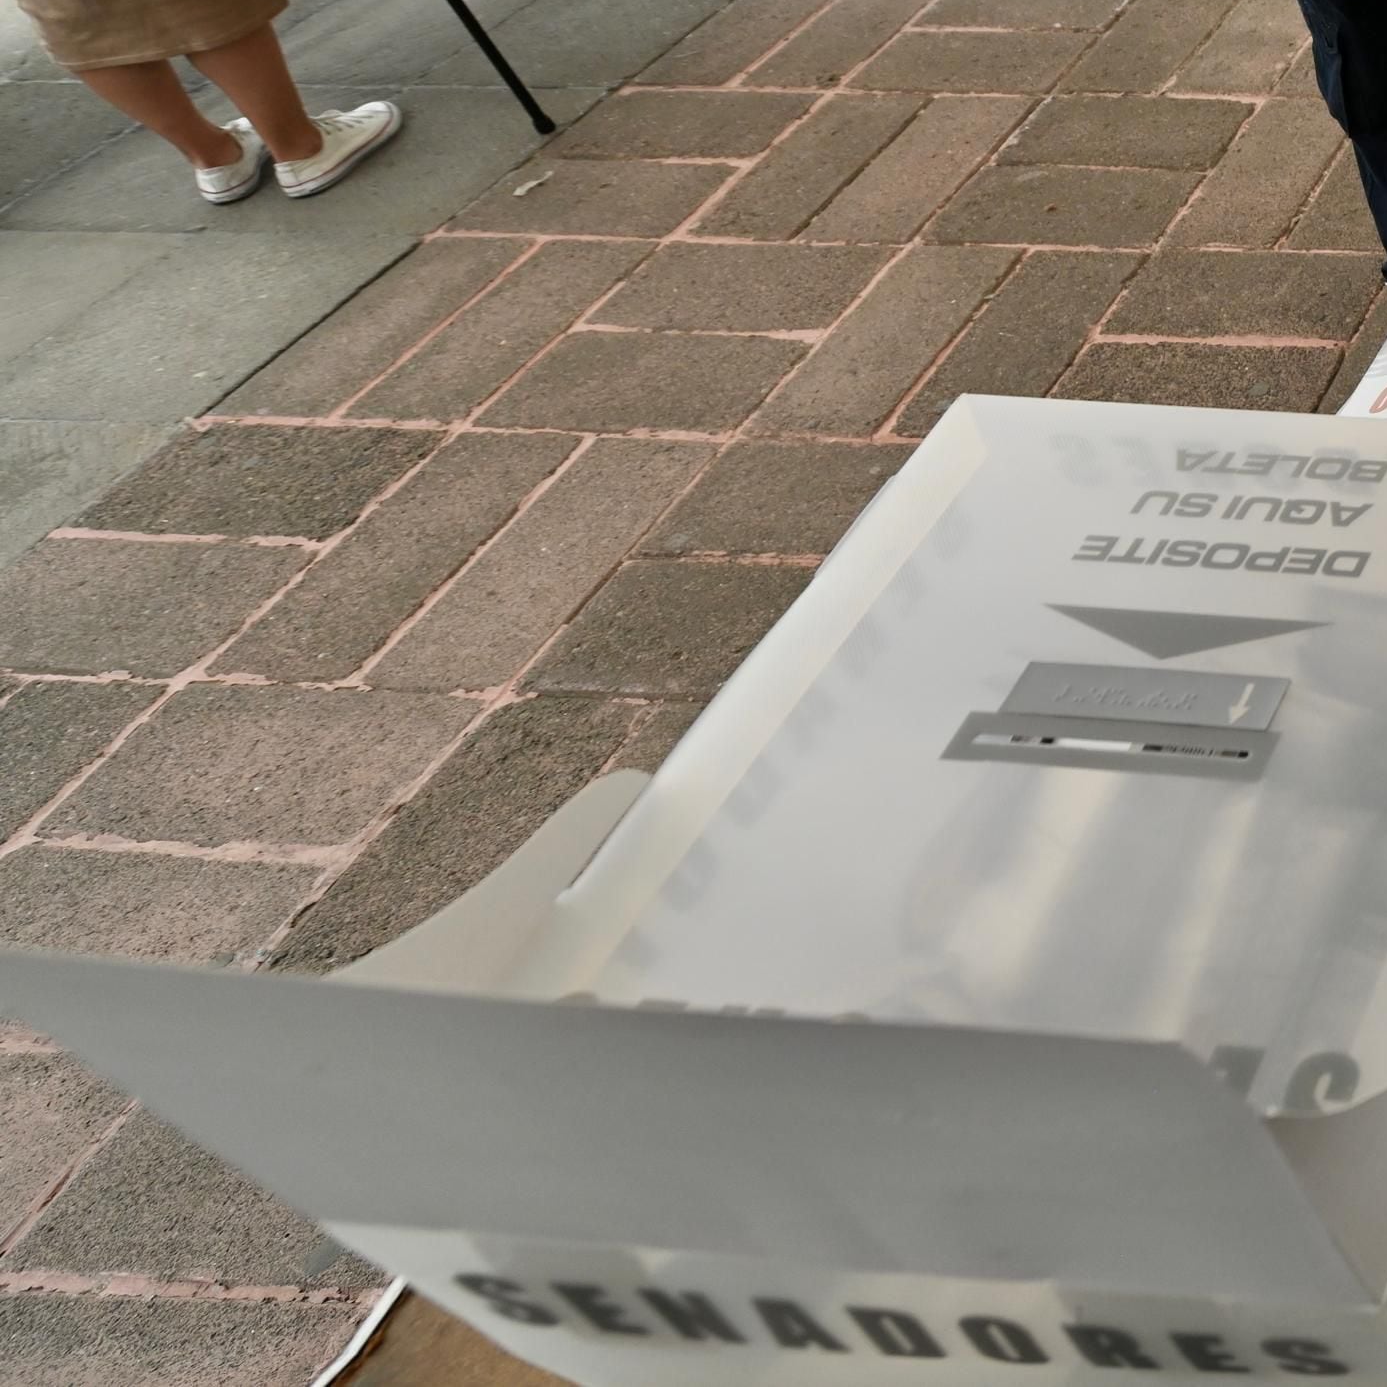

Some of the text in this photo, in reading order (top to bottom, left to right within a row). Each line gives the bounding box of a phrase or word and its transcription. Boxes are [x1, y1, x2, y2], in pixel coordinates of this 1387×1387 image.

[1130, 490, 1376, 528] AQUI SU
[1071, 534, 1372, 579] DEPOSITE
[452, 1270, 1353, 1377] SENADORES
